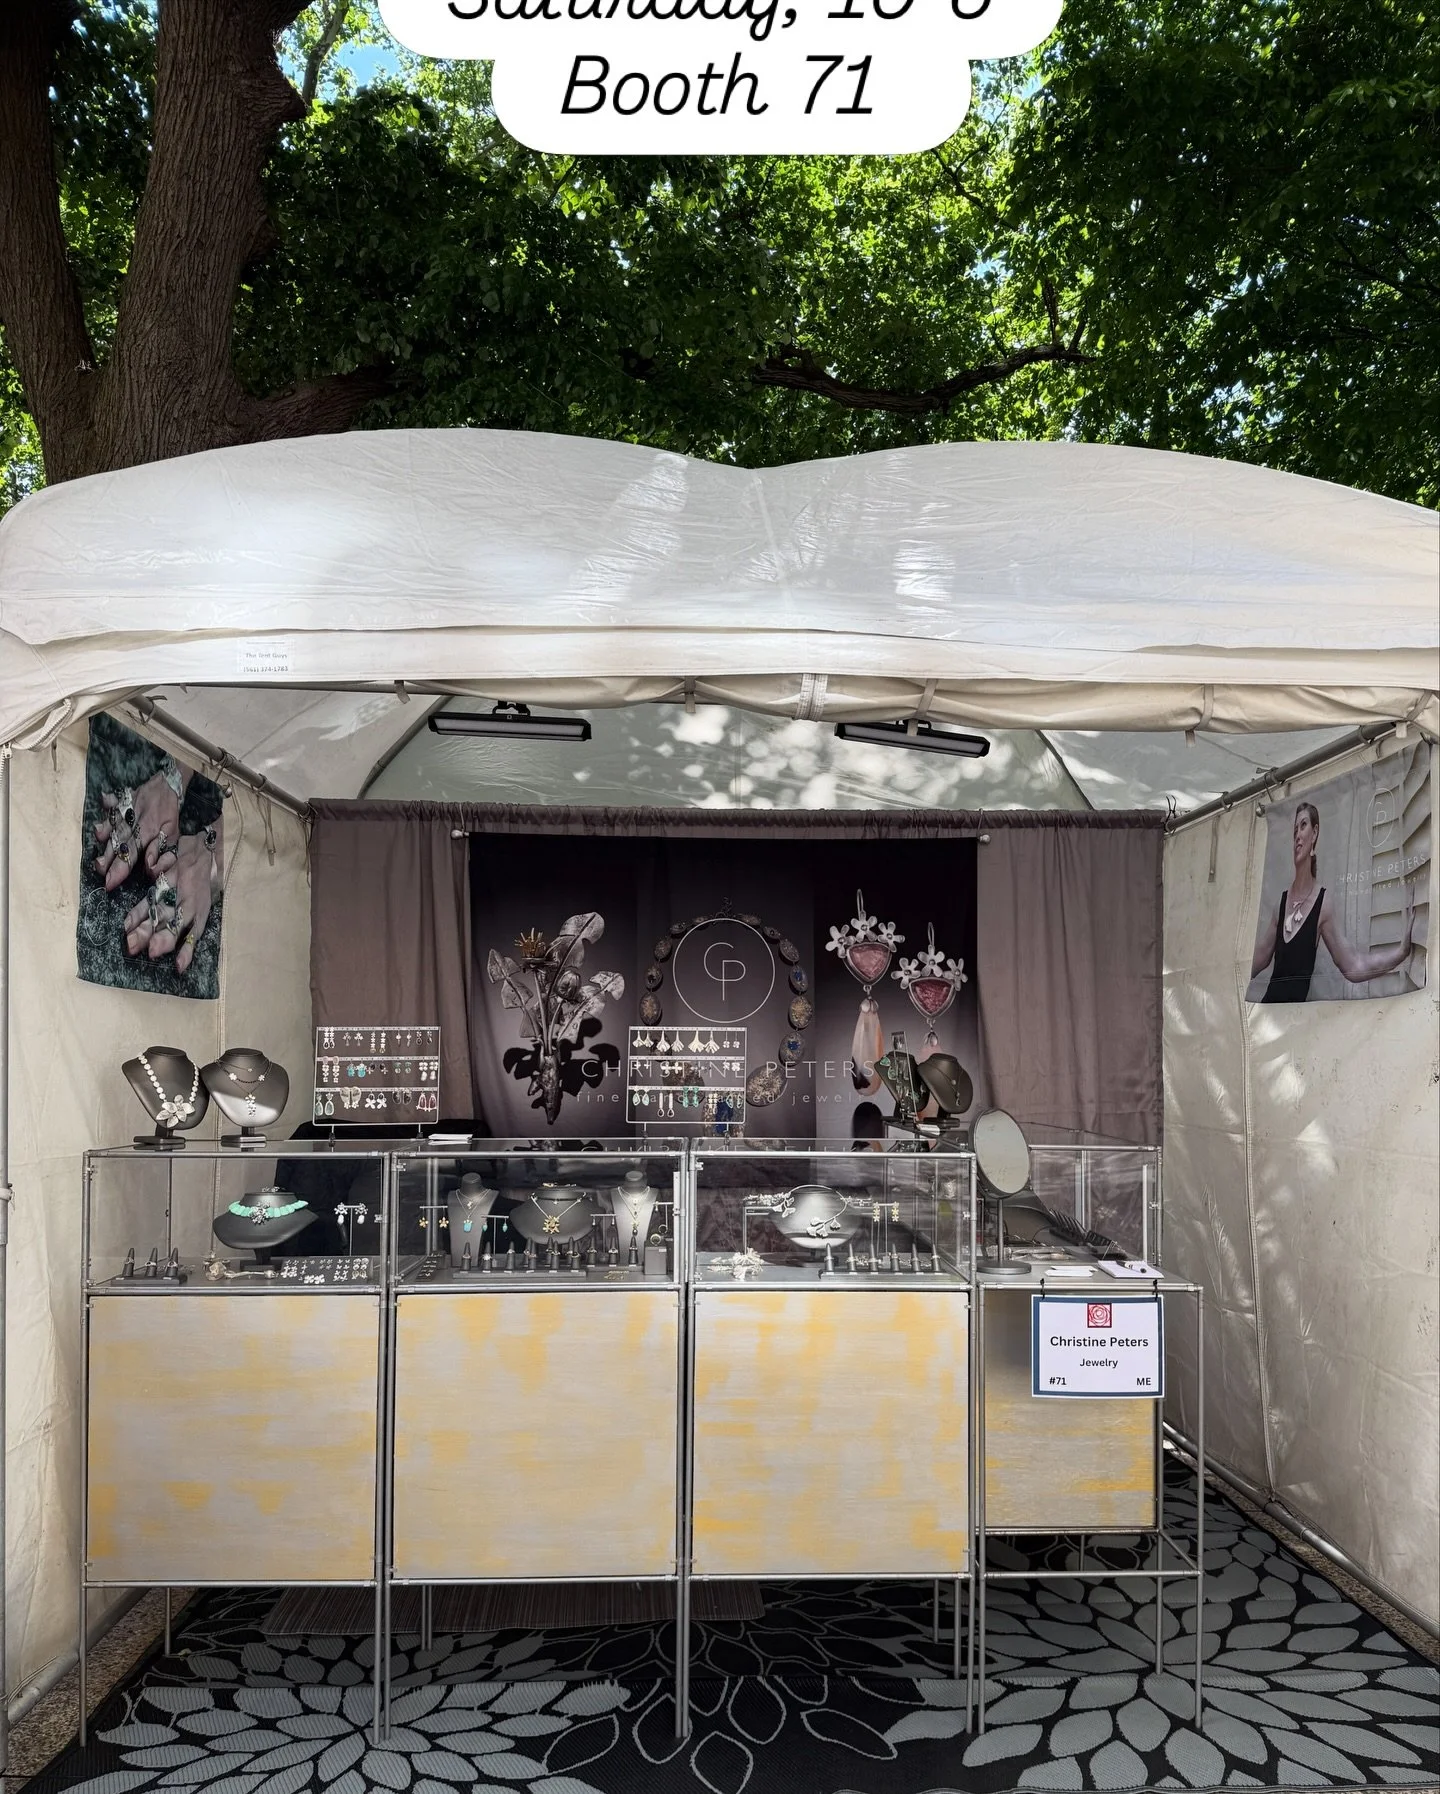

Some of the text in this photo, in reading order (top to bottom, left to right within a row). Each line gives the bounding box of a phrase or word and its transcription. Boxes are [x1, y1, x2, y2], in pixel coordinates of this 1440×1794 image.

[1387, 854, 1426, 875] PETERS
[766, 1060, 875, 1078] PETERS
[576, 1092, 620, 1103] fine
[1050, 1336, 1149, 1347] Christine Peters
[1079, 1358, 1119, 1369] Jewelry
[1049, 1376, 1152, 1386] #71 ME
